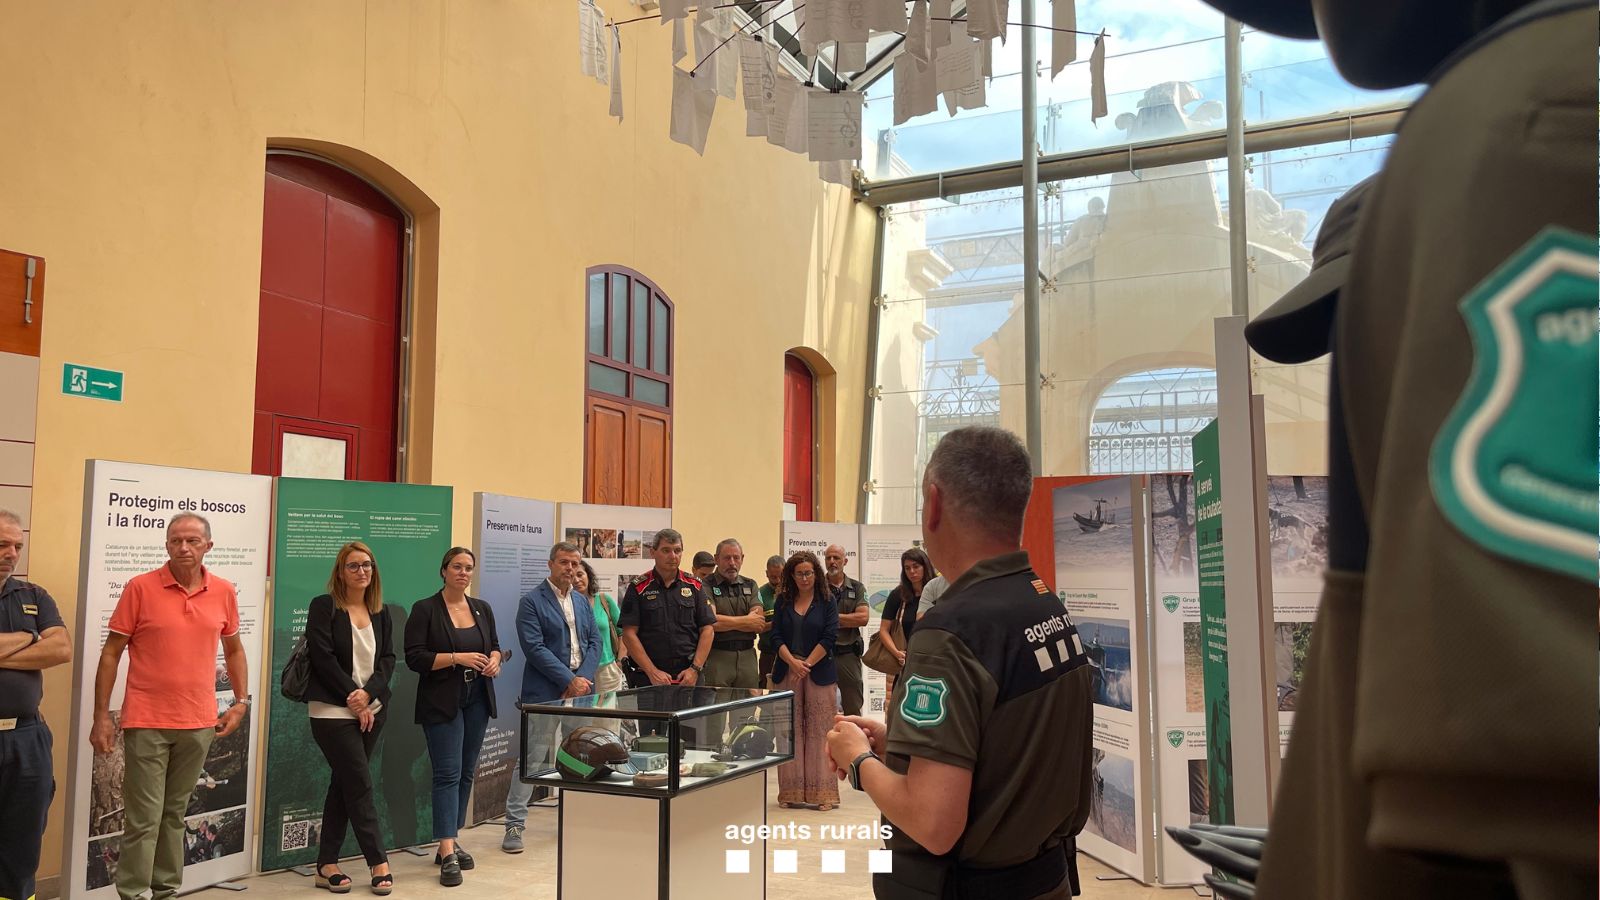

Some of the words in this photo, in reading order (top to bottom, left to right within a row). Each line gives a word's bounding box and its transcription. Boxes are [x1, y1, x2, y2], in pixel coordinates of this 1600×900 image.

[109, 492, 174, 513] Protegim
[178, 497, 198, 512] els
[201, 499, 246, 514] boscos
[108, 513, 111, 527] i
[116, 514, 129, 528] la
[133, 515, 166, 530] flora
[486, 520, 519, 532] Preservem
[520, 523, 525, 533] la
[526, 523, 542, 534] fauna
[1024, 614, 1065, 643] agents
